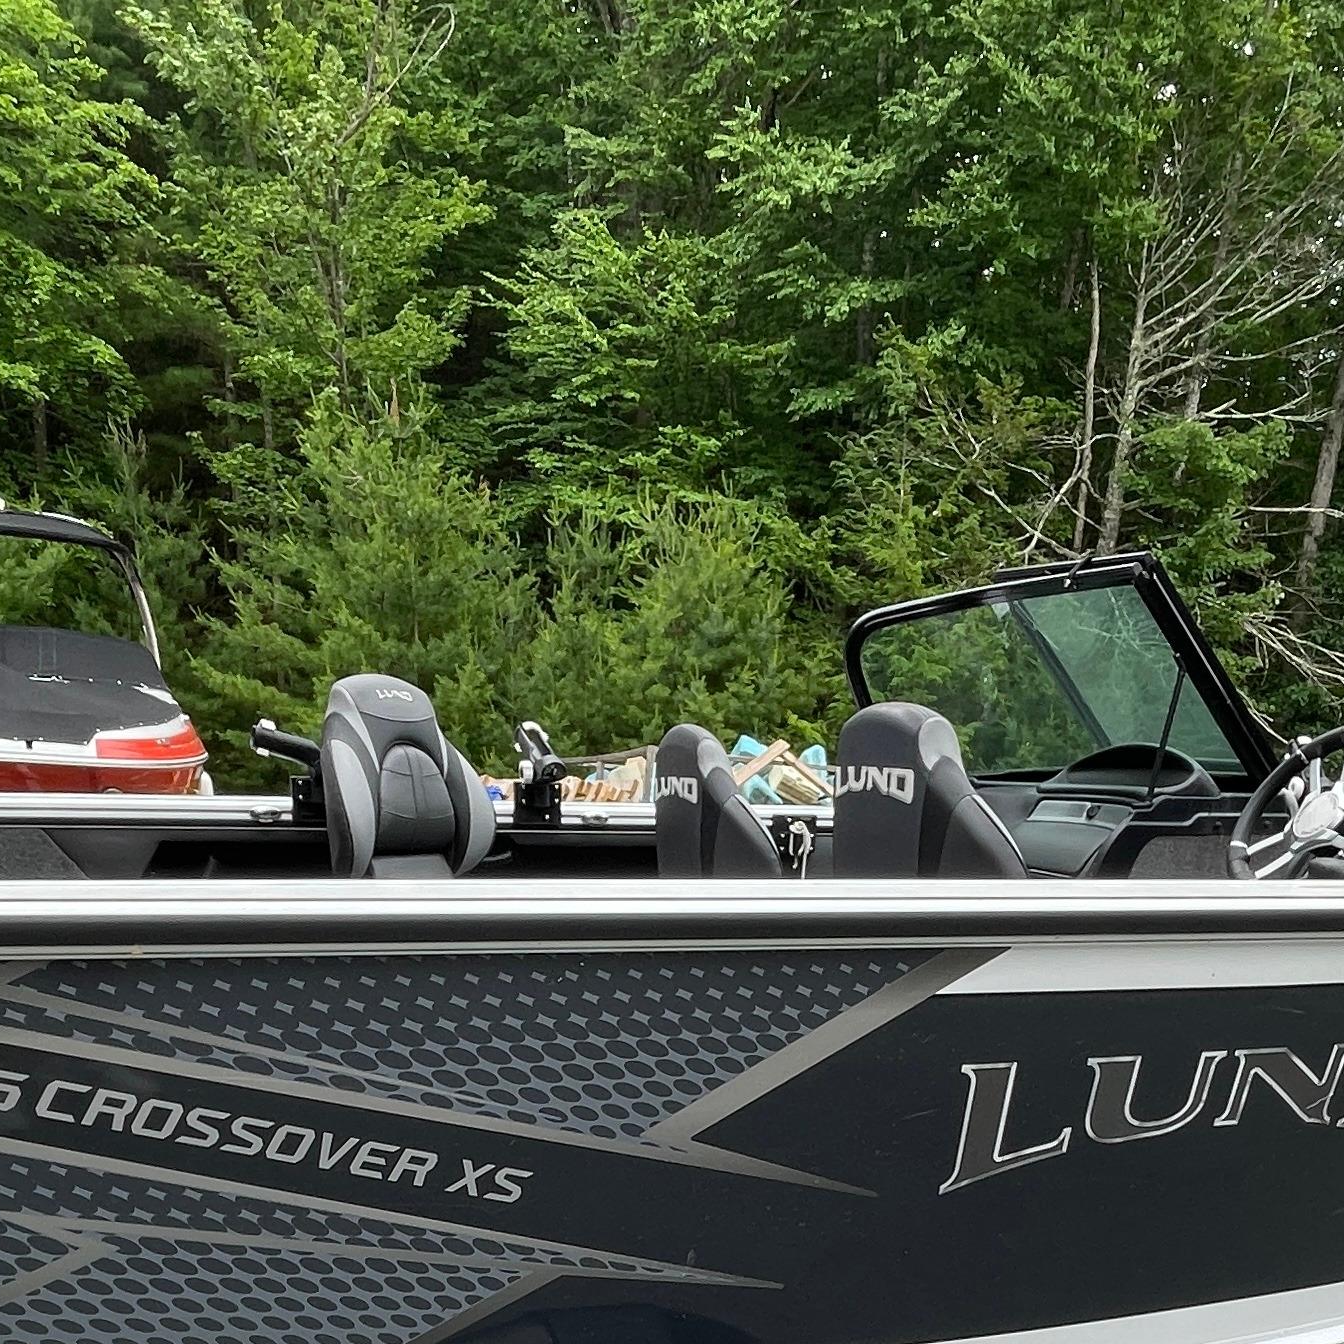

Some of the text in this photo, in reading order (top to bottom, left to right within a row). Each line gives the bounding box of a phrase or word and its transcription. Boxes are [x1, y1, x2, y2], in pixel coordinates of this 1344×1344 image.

[656, 775, 699, 805] LUND
[834, 765, 915, 805] LUND
[34, 1079, 438, 1187] CROSSOVER
[446, 1158, 534, 1204] XS
